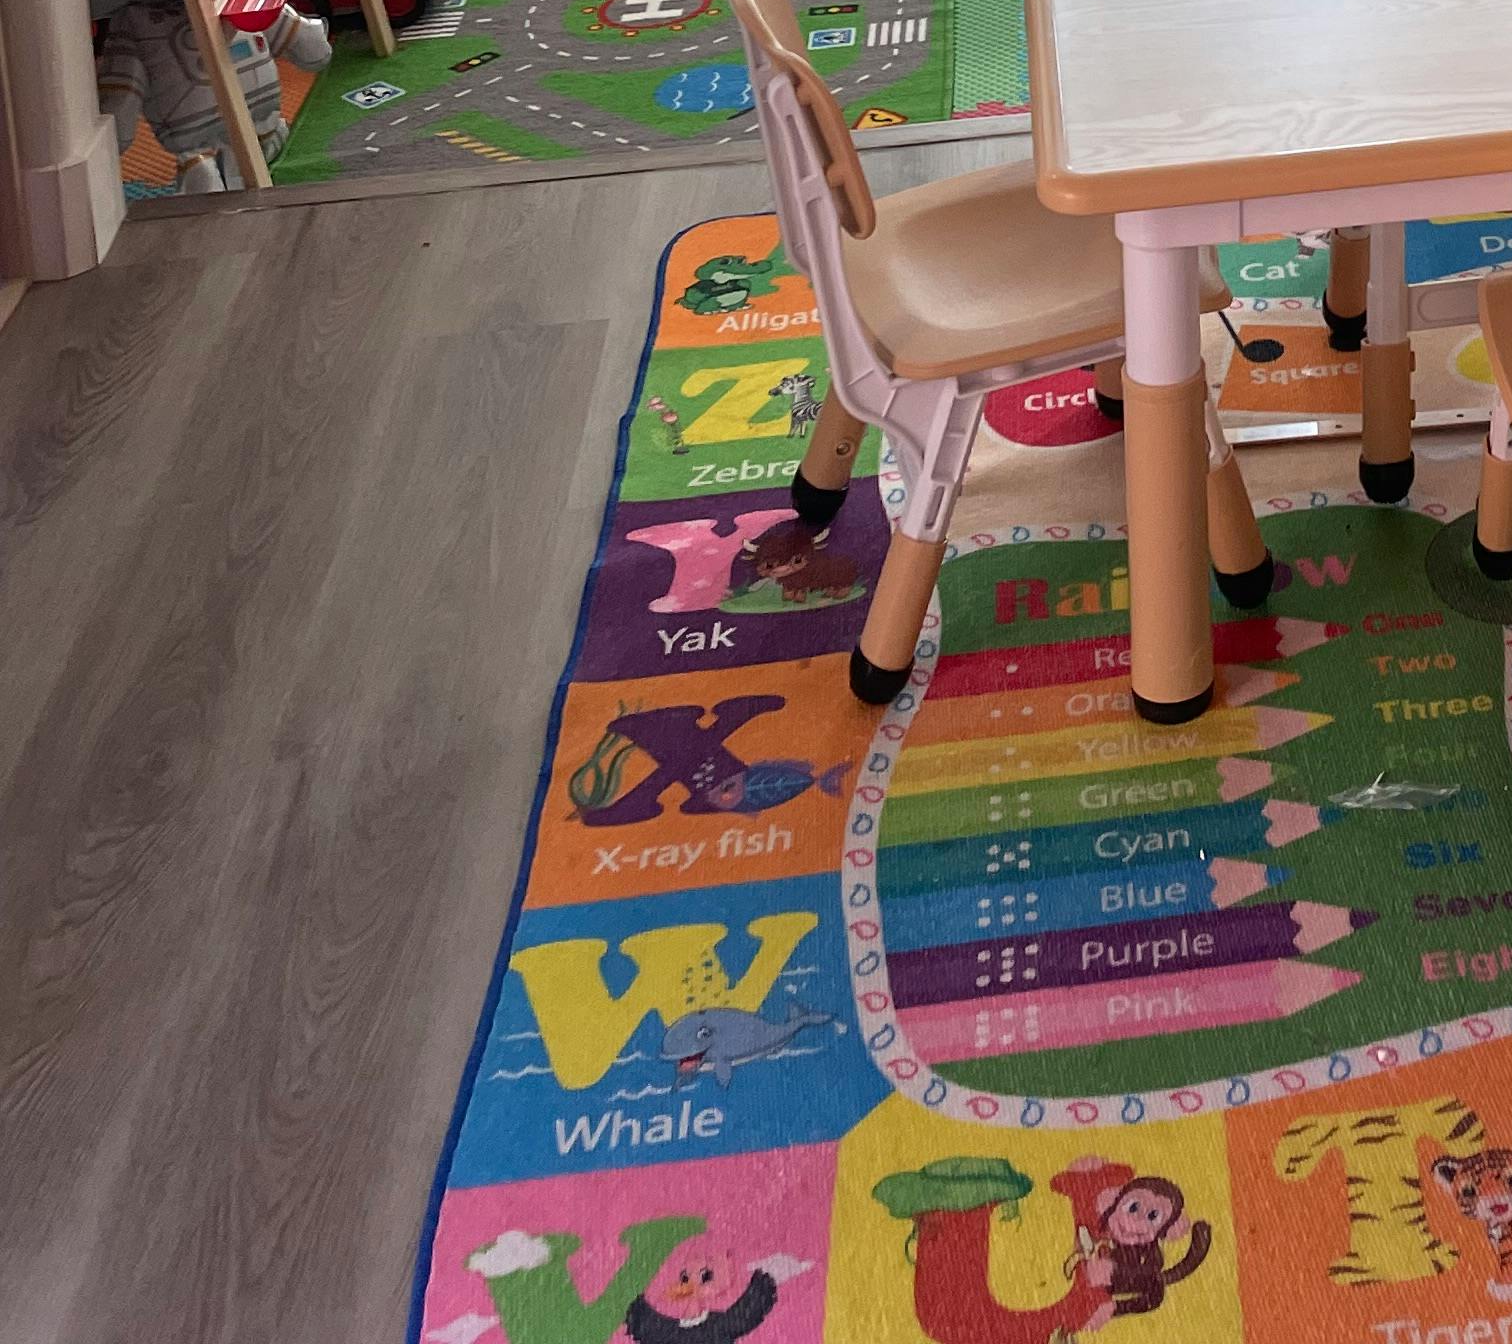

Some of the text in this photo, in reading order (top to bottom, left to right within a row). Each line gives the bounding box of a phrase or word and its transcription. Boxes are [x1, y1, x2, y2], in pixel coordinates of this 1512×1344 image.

[1239, 260, 1300, 284] Cat
[716, 306, 823, 334] Alligat
[1250, 358, 1361, 386] Square
[681, 358, 809, 445] Z
[1024, 387, 1096, 413] Circl
[687, 458, 800, 488] Zebra
[625, 509, 799, 612] Y
[657, 621, 738, 655] Yak
[1094, 646, 1133, 671] Re
[1370, 653, 1457, 675] Two
[1065, 692, 1134, 717] Ora
[1375, 694, 1494, 724] Three
[574, 694, 787, 828] X
[1077, 730, 1199, 762] Yellow
[1079, 775, 1197, 812] Green
[592, 824, 793, 875] X-ray fish
[1096, 823, 1190, 864] Cyan
[1405, 839, 1483, 870] Six
[1102, 876, 1188, 912] Blue
[1083, 928, 1216, 969] Purple
[509, 912, 818, 1090] W
[1107, 986, 1200, 1025] Pink
[555, 1102, 725, 1157] Whale
[1275, 1094, 1486, 1288] T
